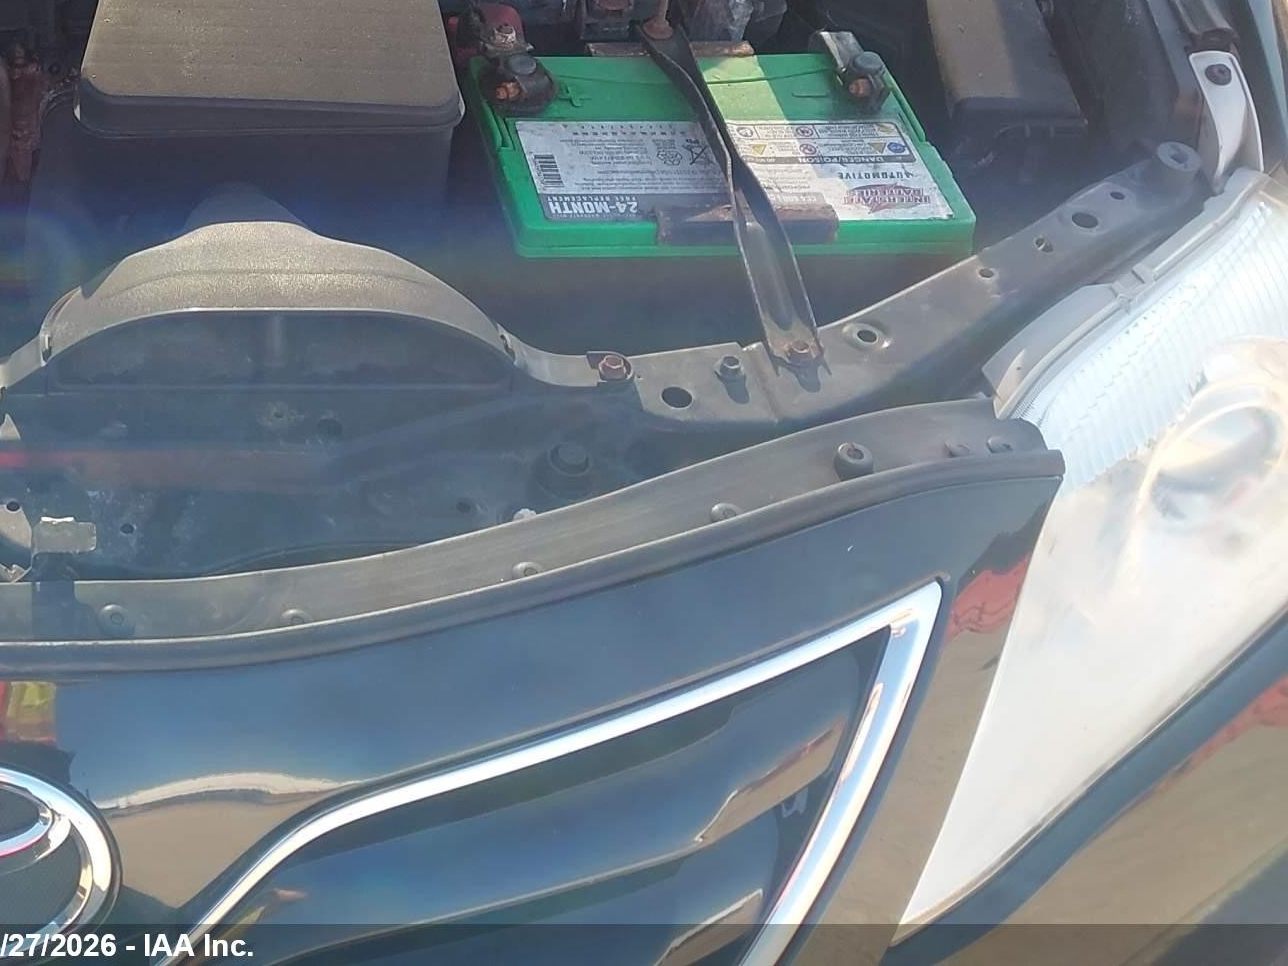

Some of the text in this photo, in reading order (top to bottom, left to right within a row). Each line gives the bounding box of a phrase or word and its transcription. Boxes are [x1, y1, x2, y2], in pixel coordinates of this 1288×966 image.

[837, 171, 913, 180] AUTOMOTIVE
[846, 188, 924, 197] BATTERIES
[842, 195, 931, 205] INTERSTATE
[548, 201, 638, 214] 24-MONTH
